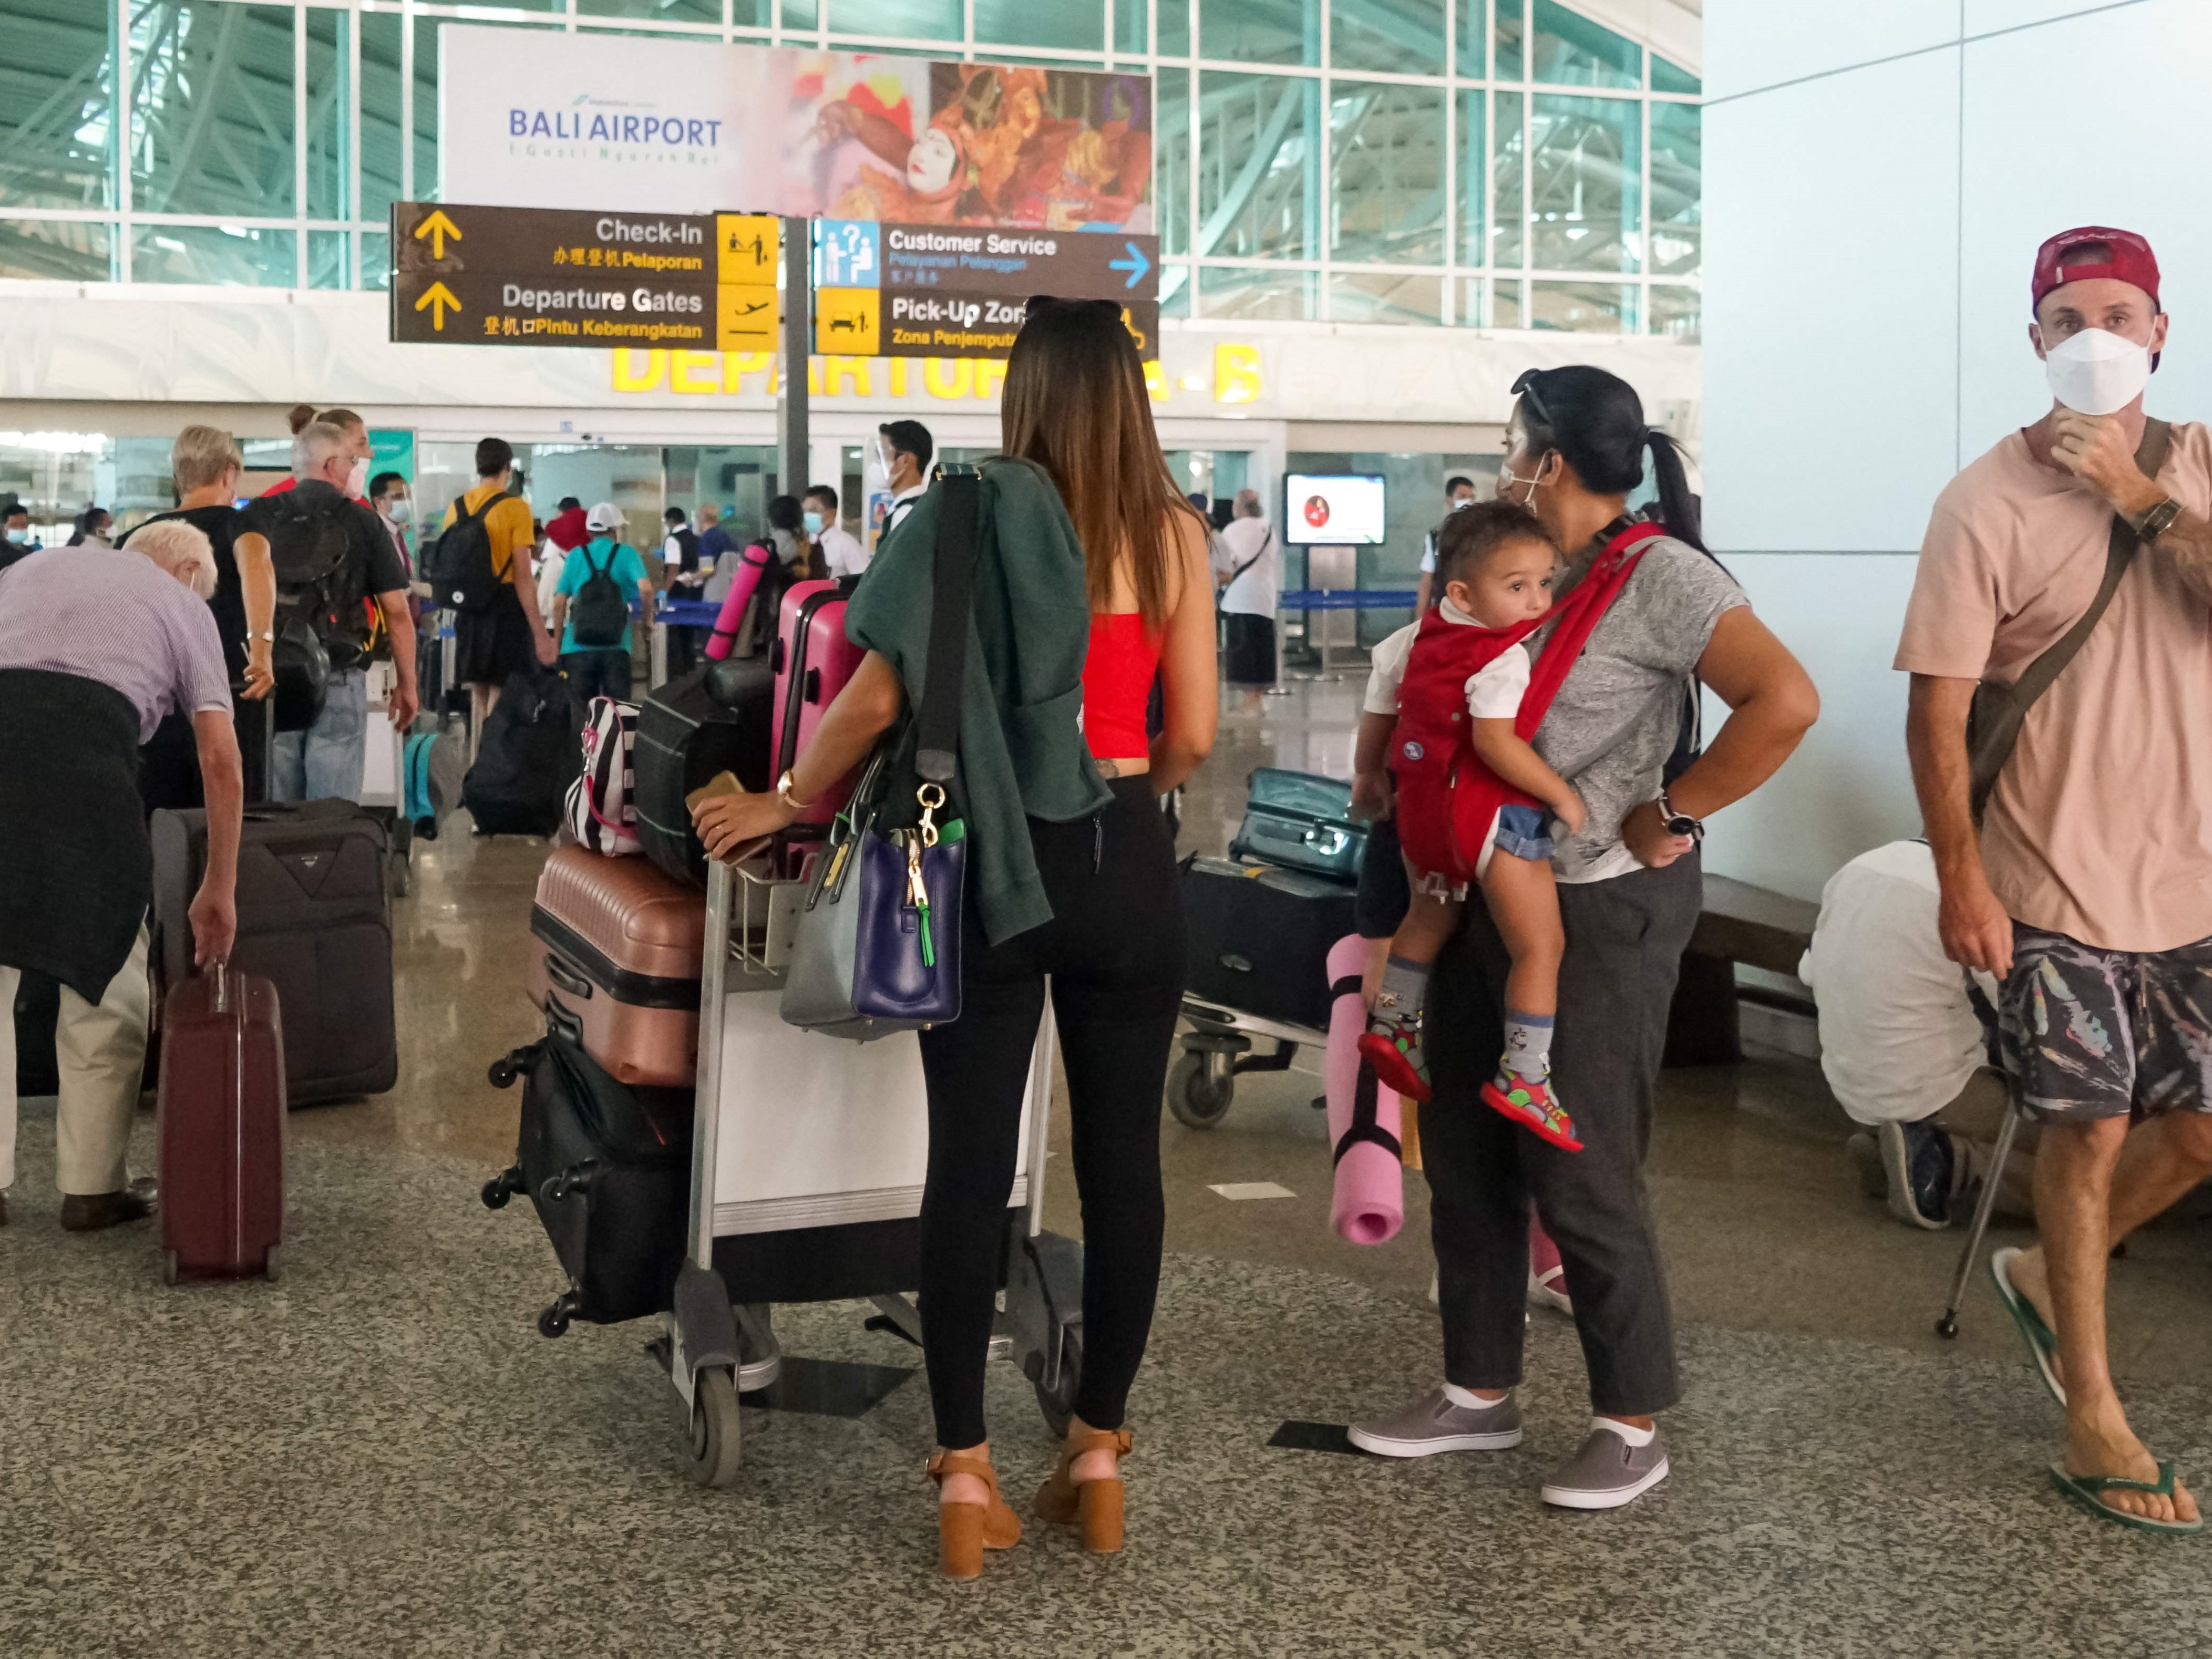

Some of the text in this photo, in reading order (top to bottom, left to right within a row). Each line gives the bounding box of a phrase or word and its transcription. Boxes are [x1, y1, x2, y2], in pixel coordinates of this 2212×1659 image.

[509, 109, 722, 147] BALI AIRPORT
[596, 219, 702, 244] Check-In
[889, 230, 1057, 255] Customer Service
[622, 251, 703, 272] Pelaporan
[503, 284, 703, 313] Departure Gates
[892, 297, 1025, 328] Pick-Up Zon
[536, 318, 578, 336] Pintu
[582, 318, 703, 341] Keberangkatan
[892, 328, 930, 345] Zona
[1215, 344, 1261, 404] B
